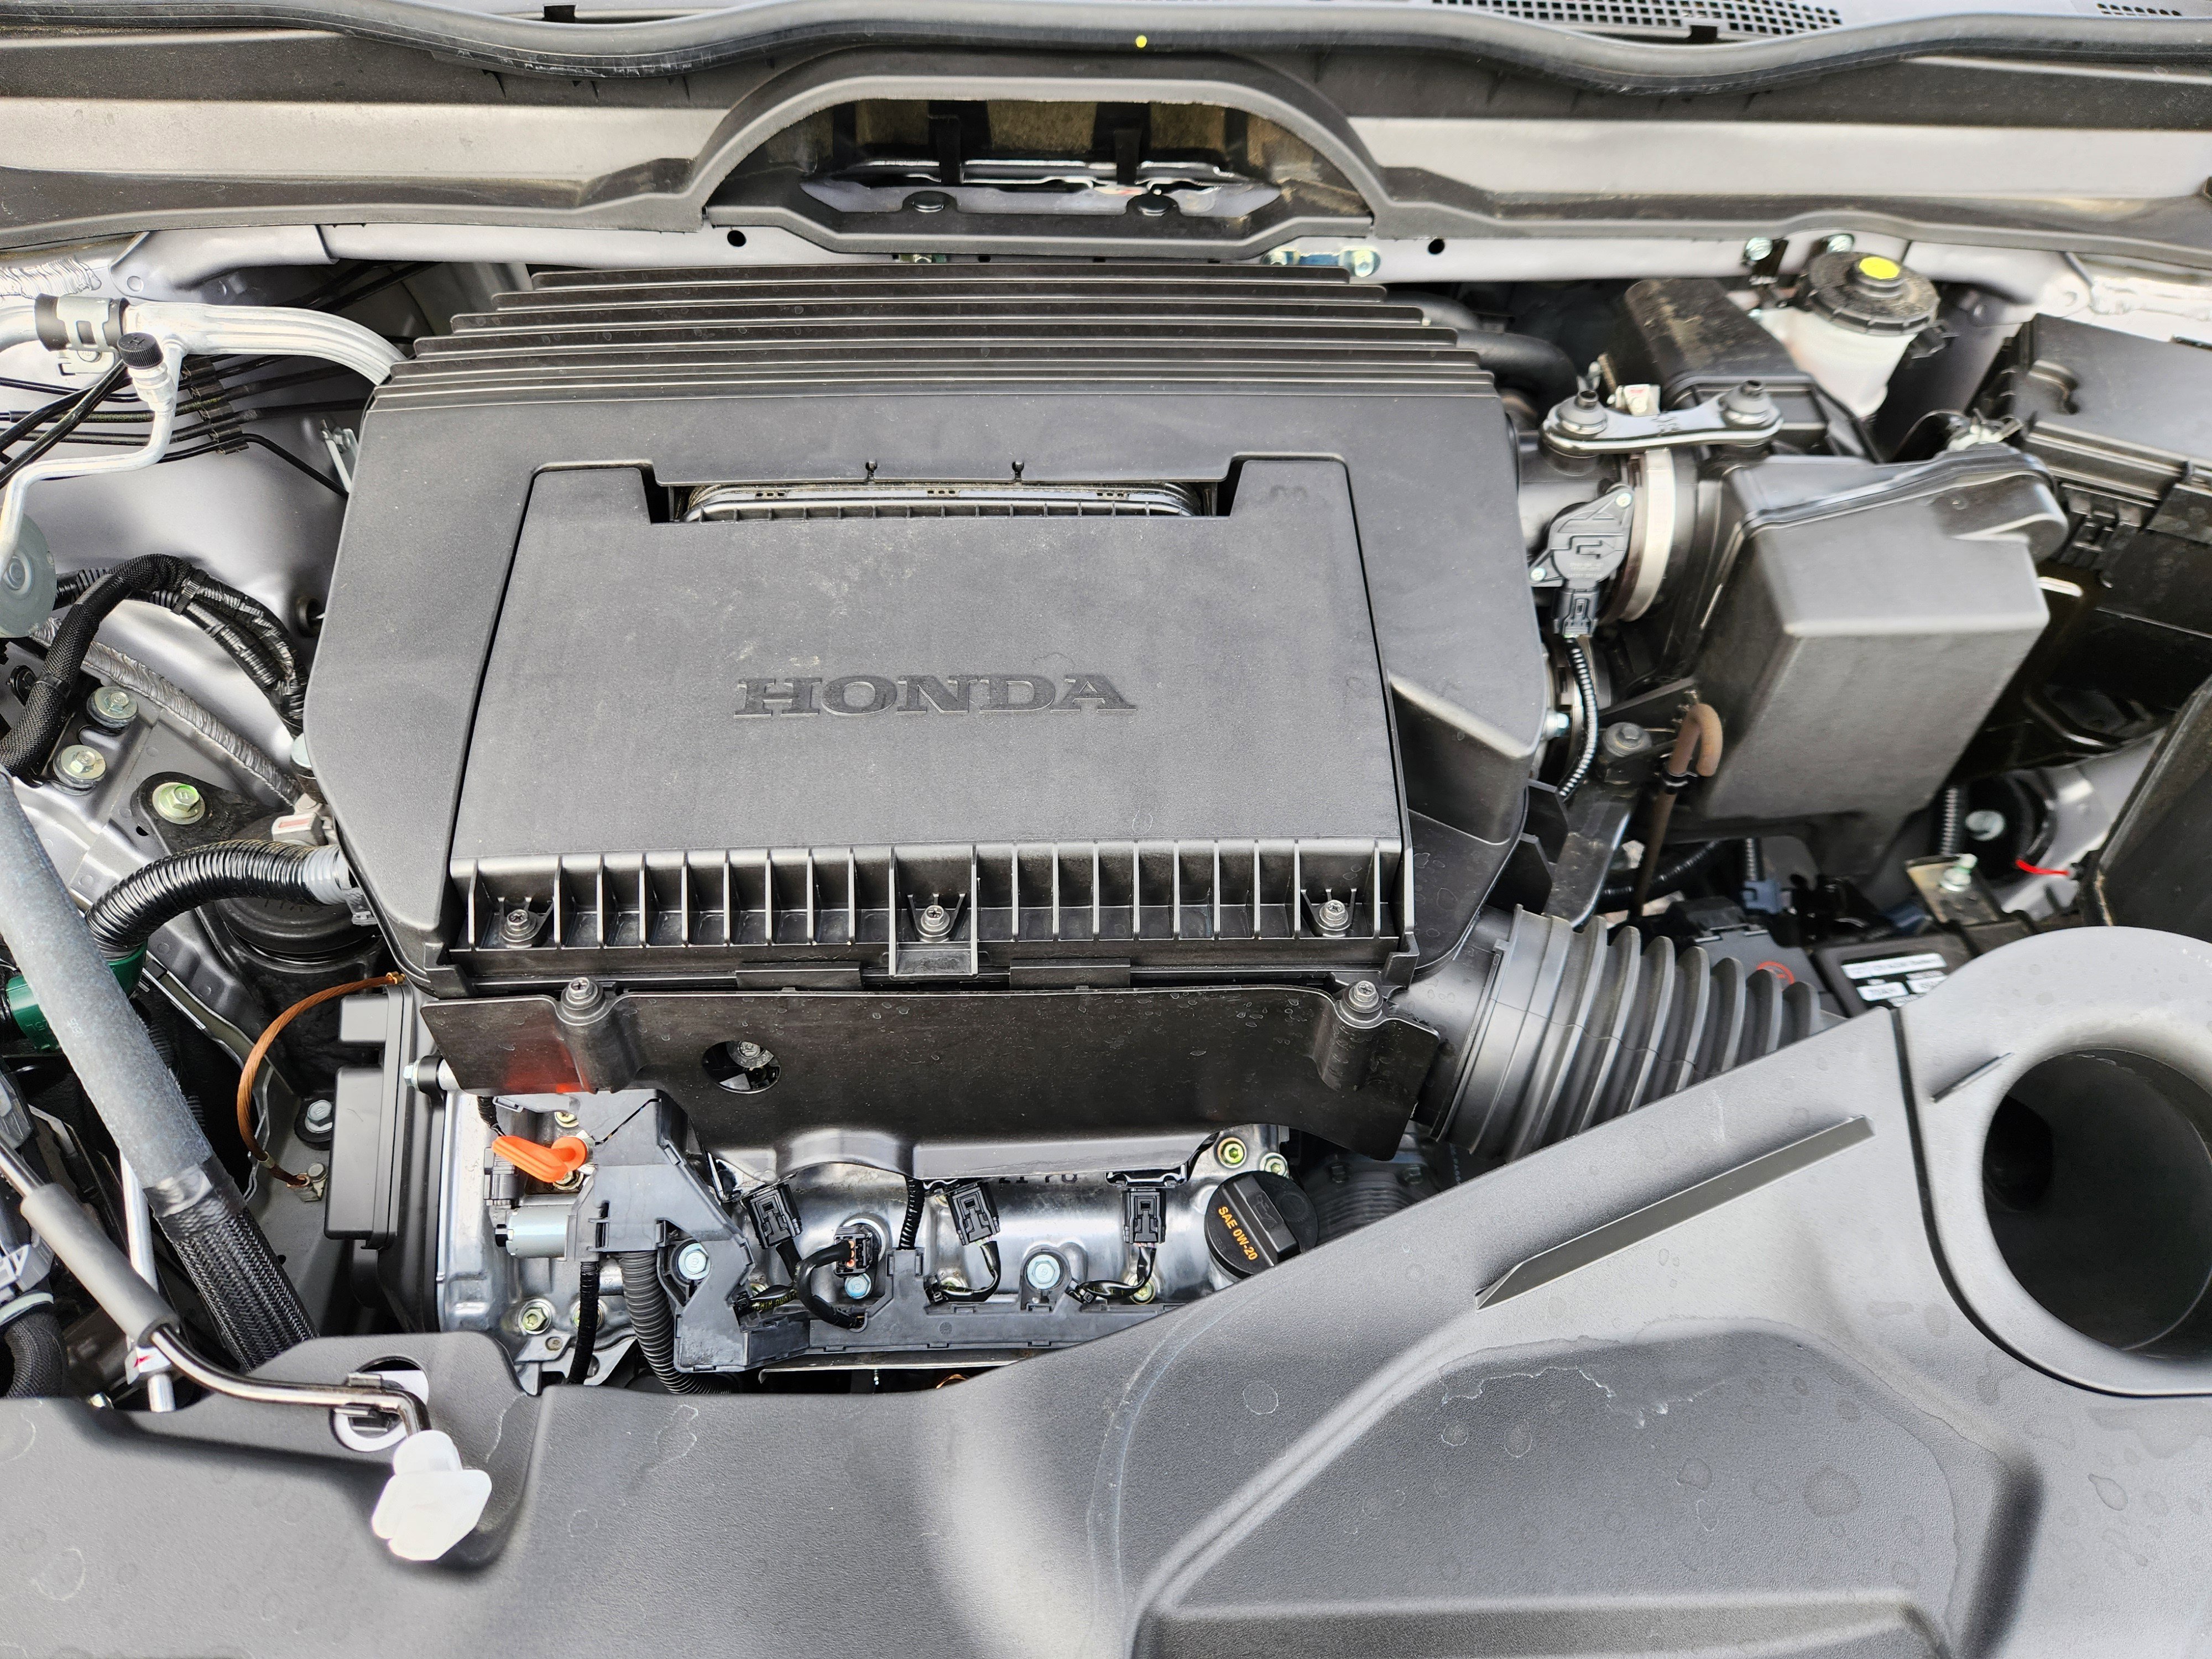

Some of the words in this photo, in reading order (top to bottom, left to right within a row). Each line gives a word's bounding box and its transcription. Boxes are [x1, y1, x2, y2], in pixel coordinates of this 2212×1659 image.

[733, 675, 1138, 718] HONDA
[1218, 1206, 1238, 1229] SAE
[1233, 1229, 1258, 1260] 0W-20
